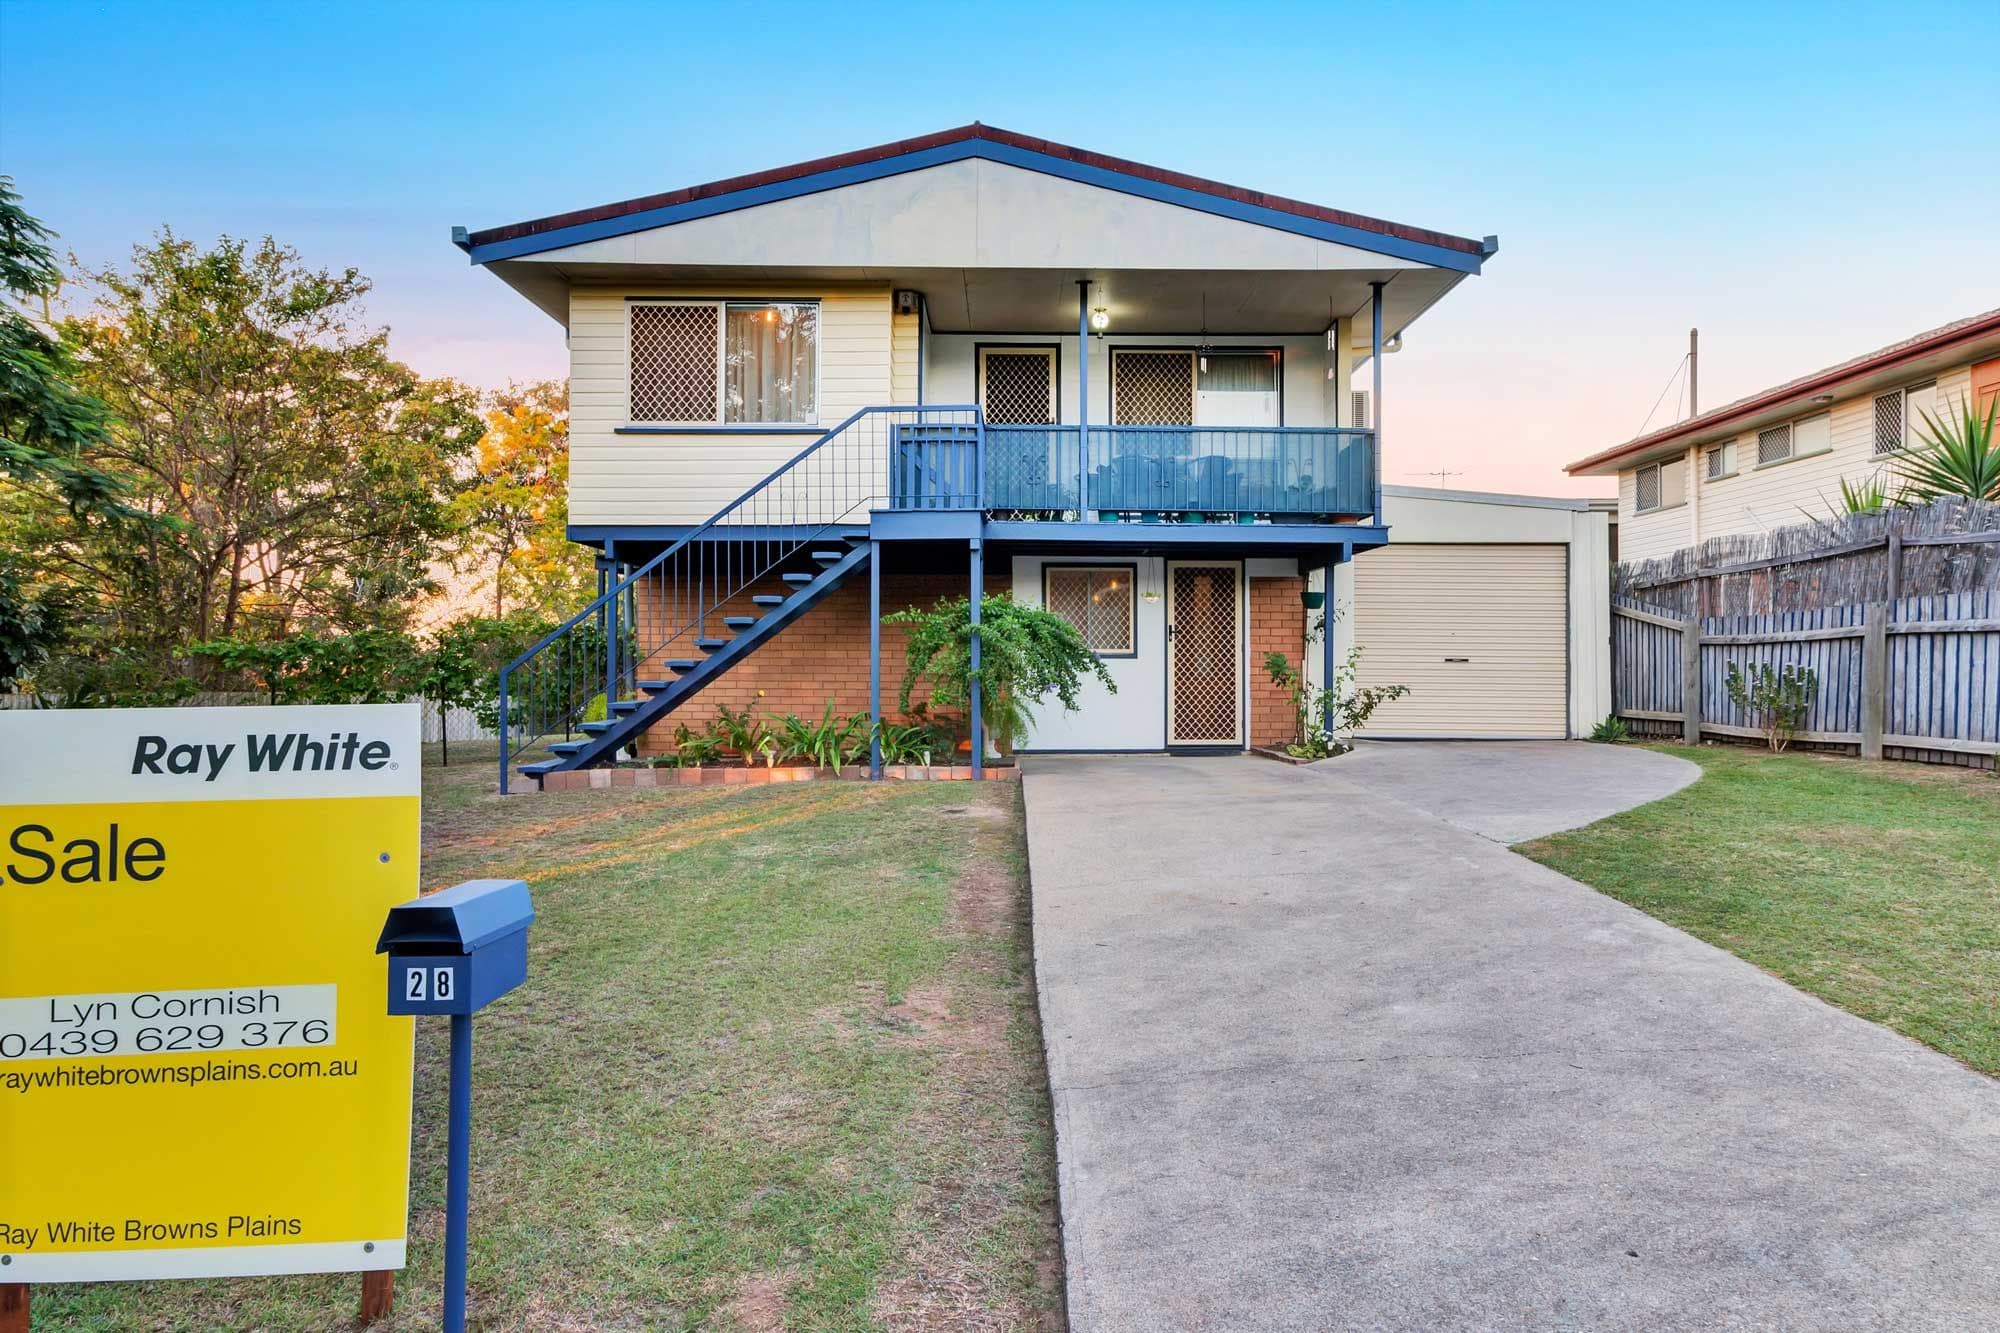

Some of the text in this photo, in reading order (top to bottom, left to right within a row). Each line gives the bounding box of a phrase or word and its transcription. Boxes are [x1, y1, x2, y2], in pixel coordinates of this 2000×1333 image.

[132, 732, 390, 781] Ray White
[6, 823, 166, 885] Sale
[50, 989, 280, 1028] Lyn Cornish
[0, 1019, 329, 1058] 0439 629 376
[47, 1221, 116, 1244] White
[124, 1218, 218, 1242] Browns
[227, 1214, 302, 1238] Plains
